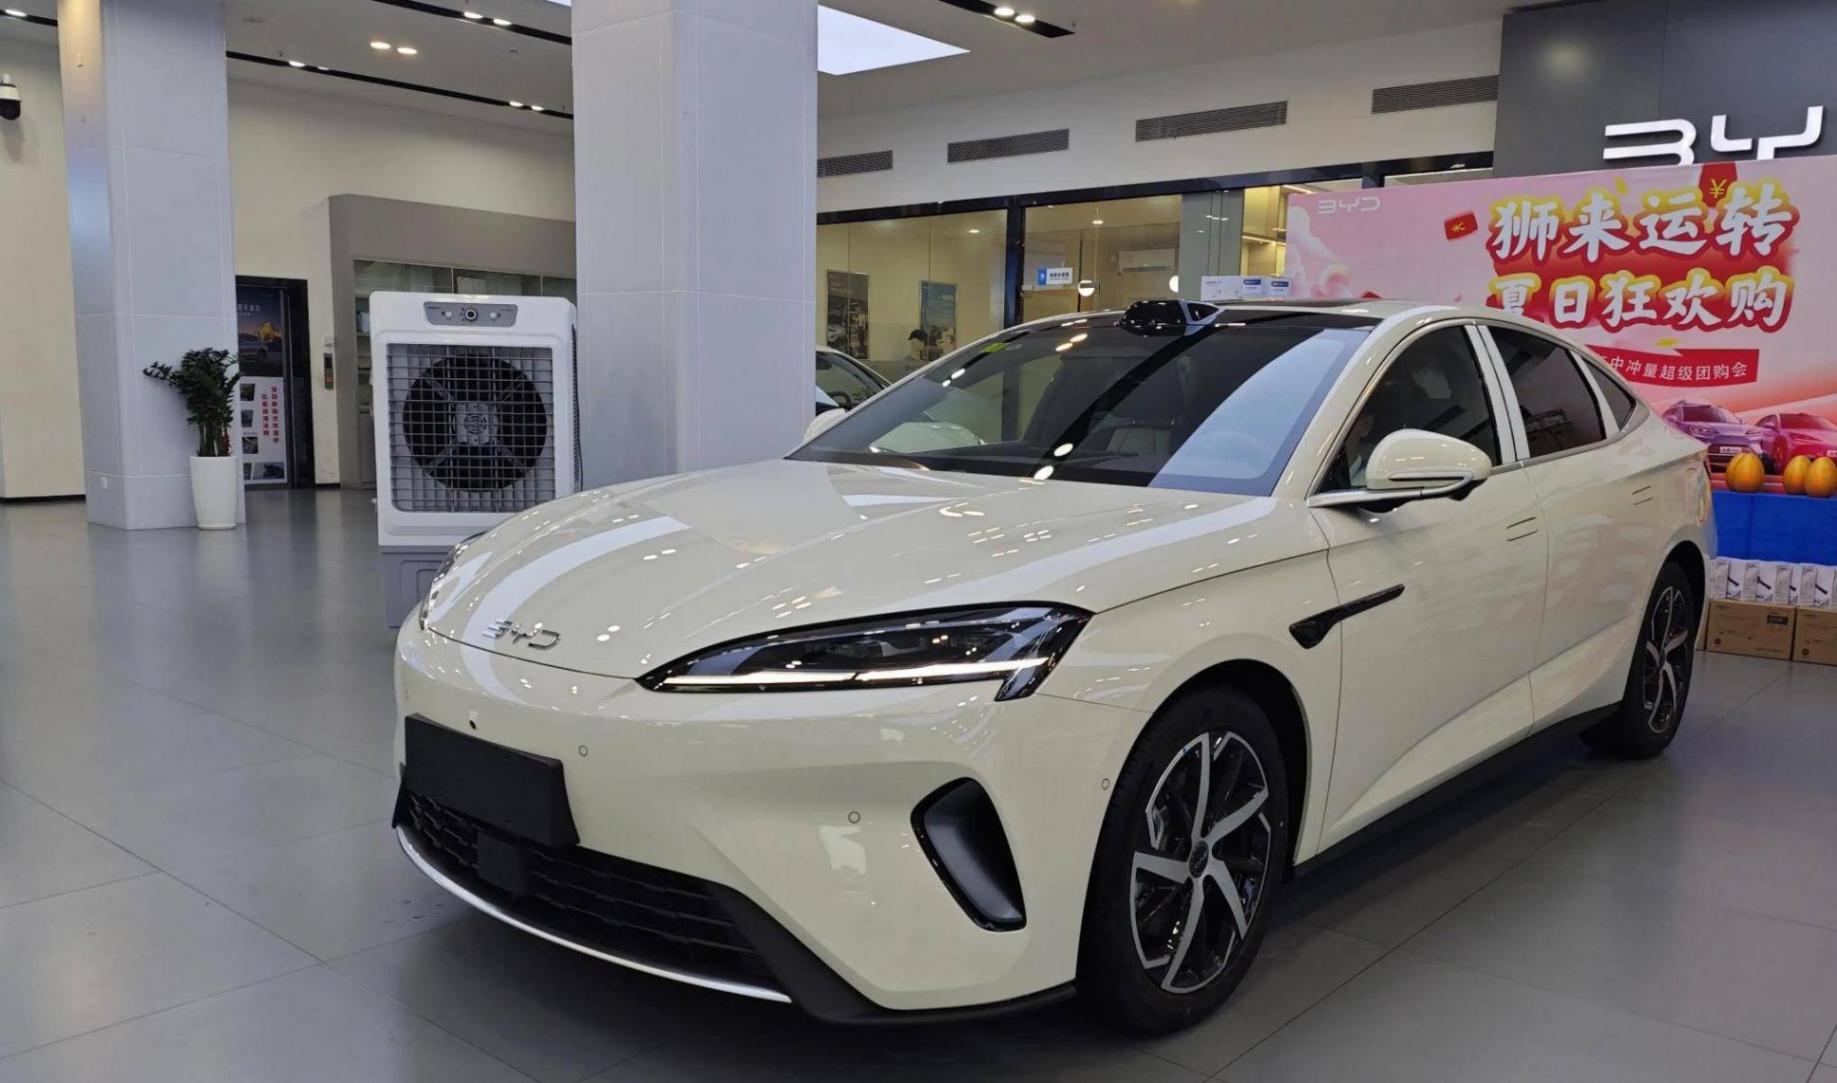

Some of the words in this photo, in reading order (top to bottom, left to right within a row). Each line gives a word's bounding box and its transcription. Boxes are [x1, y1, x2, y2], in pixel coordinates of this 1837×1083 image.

[1318, 196, 1381, 214] BYD
[1495, 184, 1792, 263] 狮来运转
[1496, 272, 1786, 327] 夏日狂欢购
[1602, 356, 1748, 382] 中冲量超级团购会
[481, 618, 561, 651] BYD
